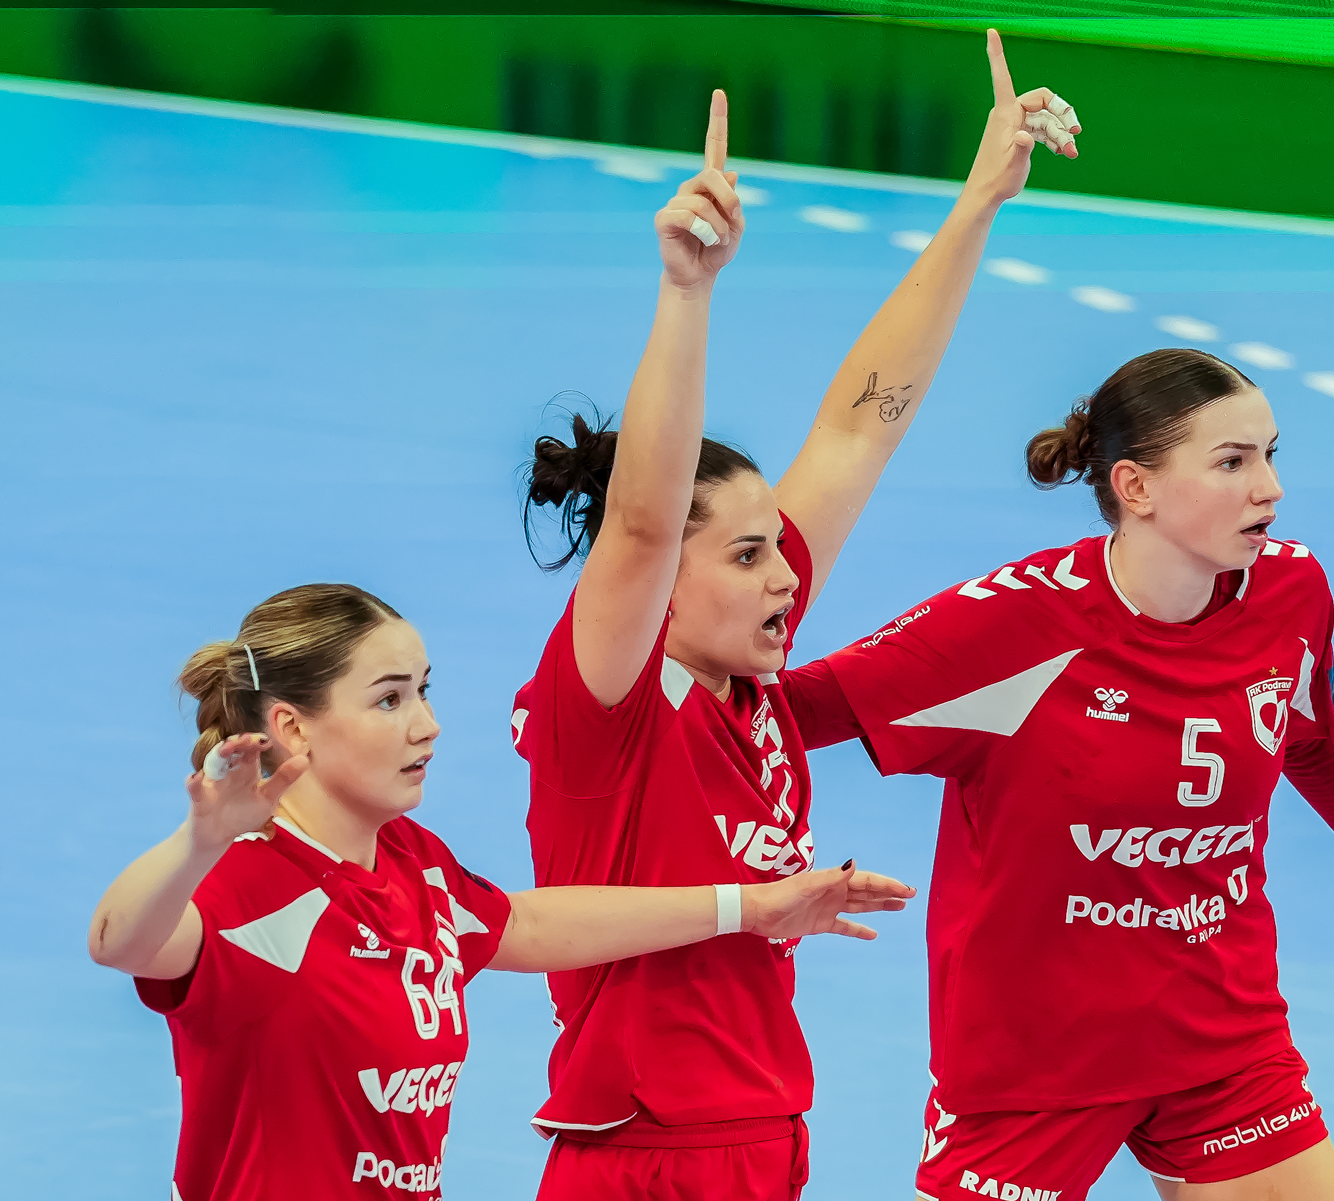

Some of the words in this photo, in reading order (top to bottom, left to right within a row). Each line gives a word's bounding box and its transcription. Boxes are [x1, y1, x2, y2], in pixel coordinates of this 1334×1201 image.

[1249, 685, 1263, 697] RK
[1262, 681, 1292, 692] Podrav
[1085, 706, 1130, 723] hummel
[1177, 717, 1225, 807] 5
[1069, 819, 1255, 869] VEGETA
[1065, 894, 1226, 932] Podravka
[1186, 924, 1222, 944] GRUPA
[400, 946, 464, 1041] 64
